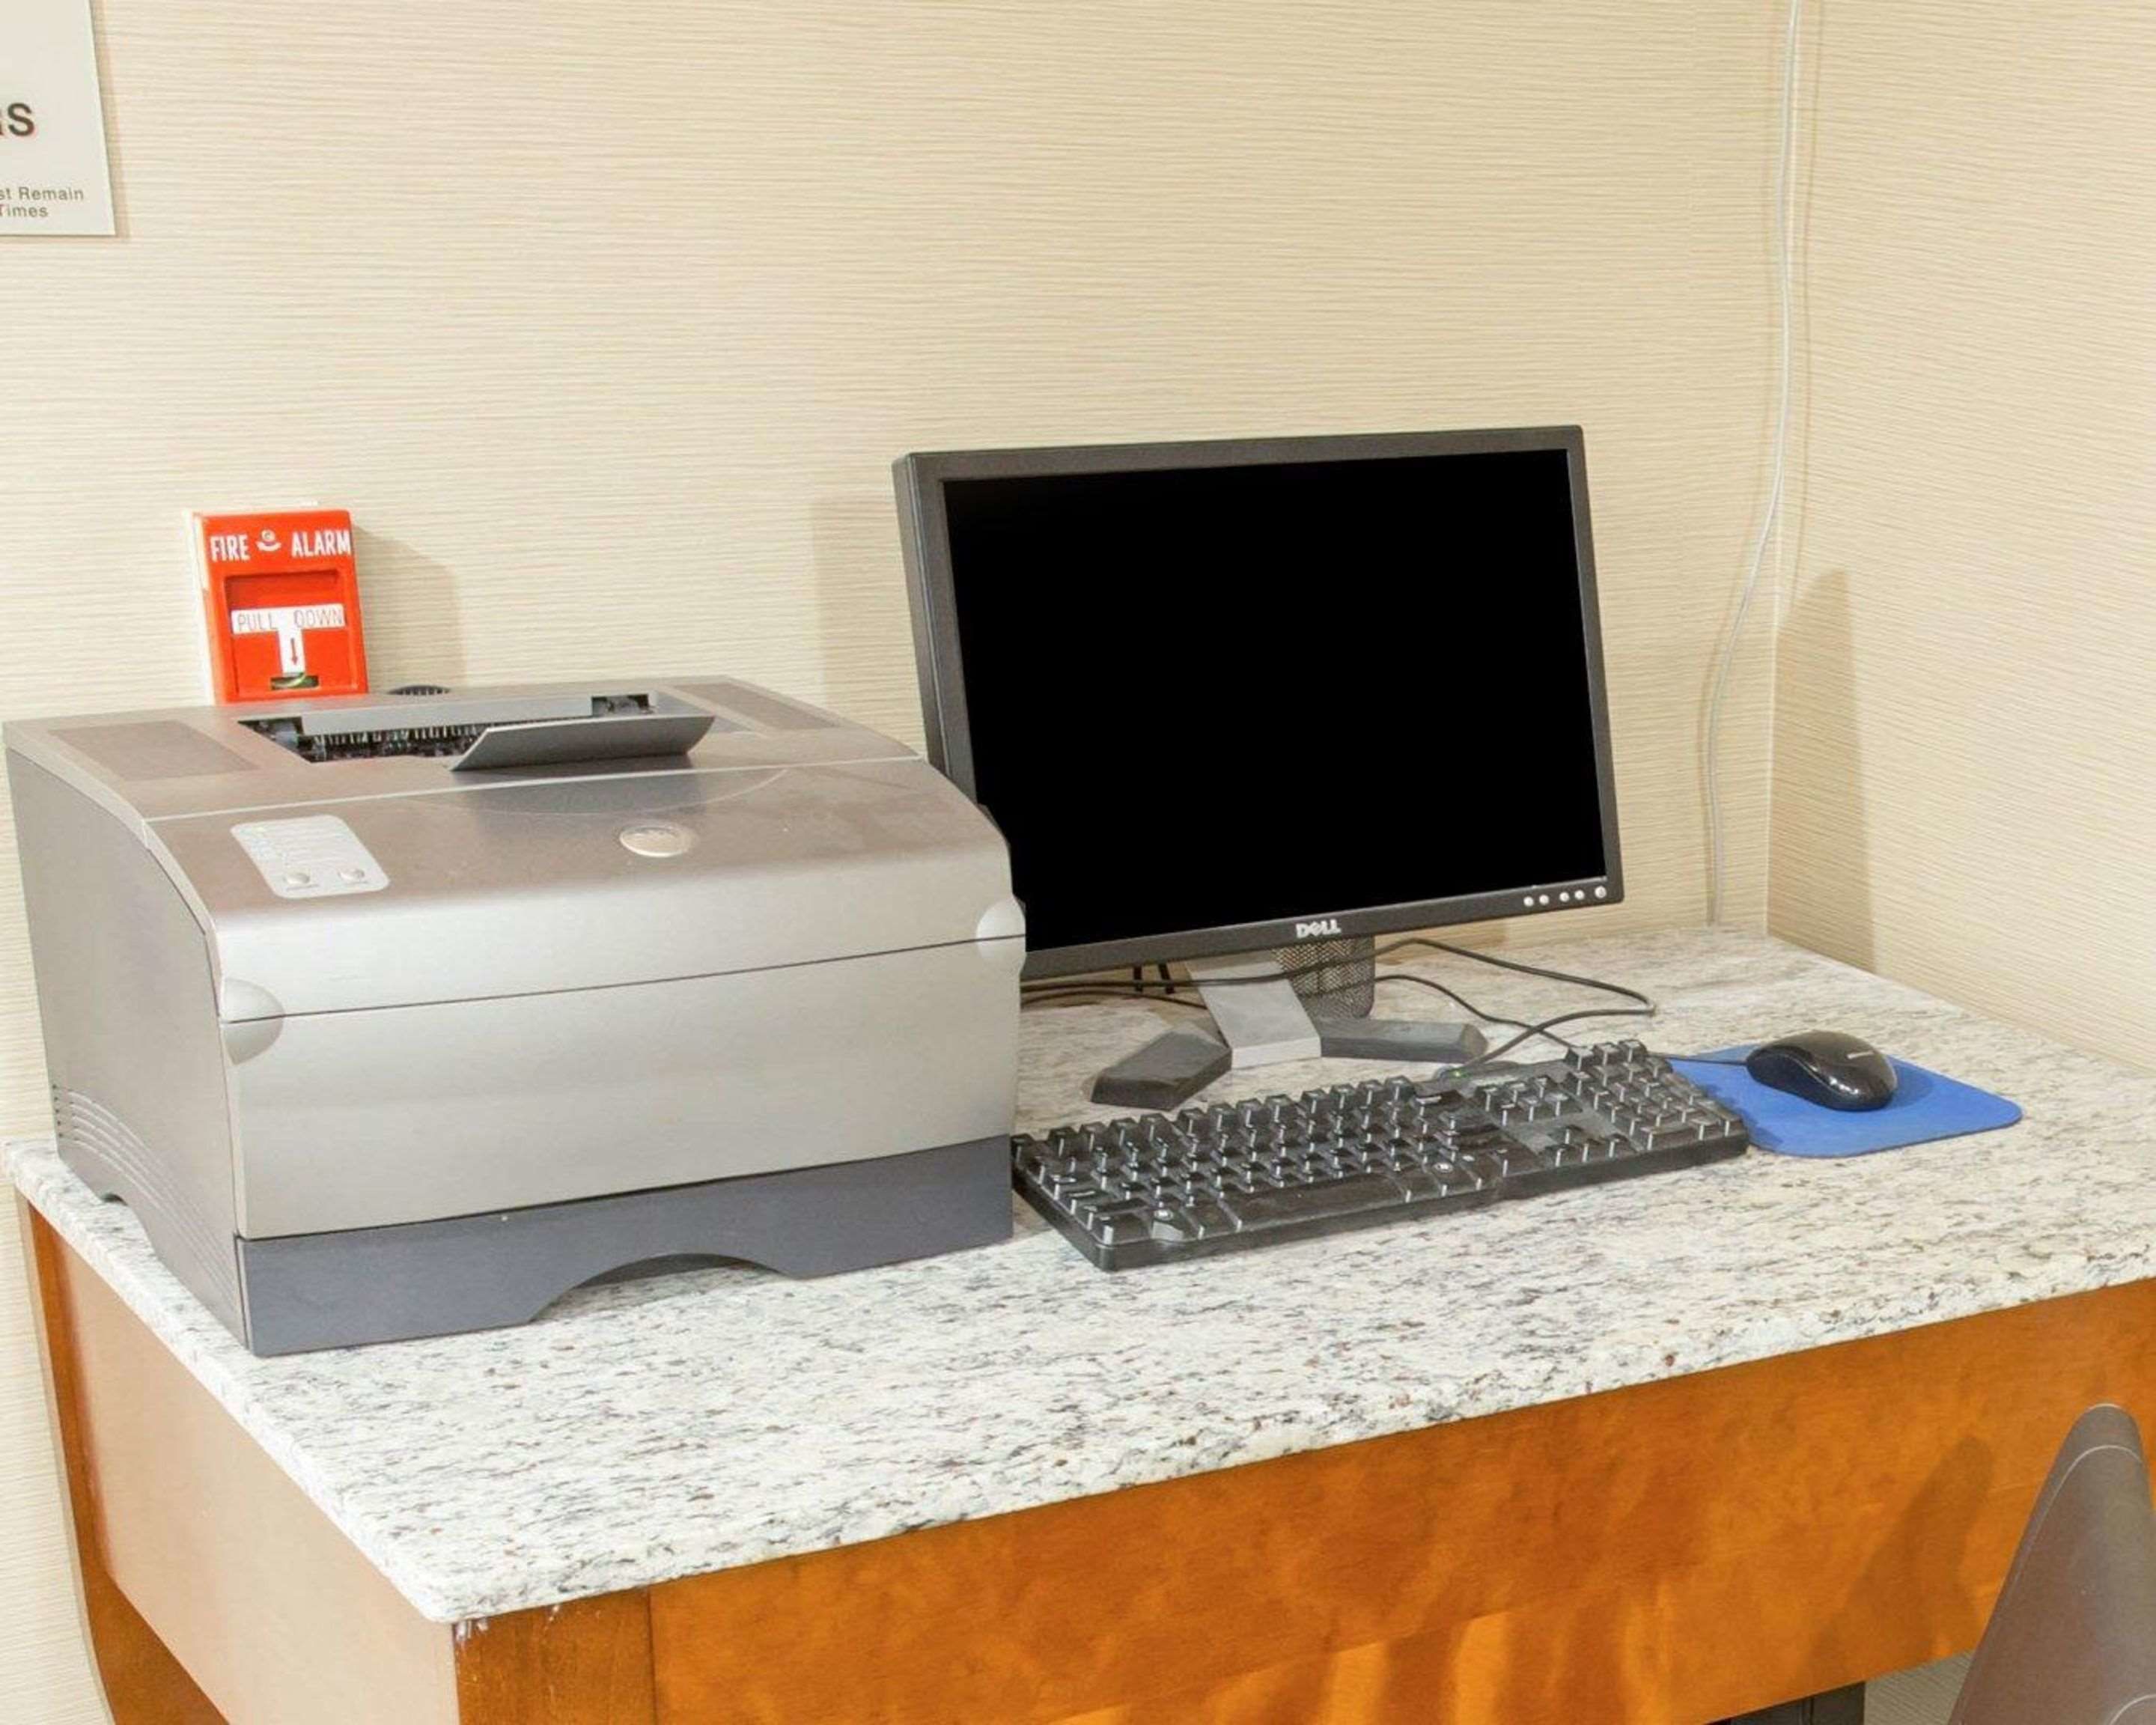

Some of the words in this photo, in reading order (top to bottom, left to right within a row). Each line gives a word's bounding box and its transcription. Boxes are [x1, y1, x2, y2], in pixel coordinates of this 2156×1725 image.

[19, 186, 84, 201] Remain
[210, 535, 250, 562] FIRE
[291, 529, 352, 558] ALARM
[237, 612, 278, 631] PULL
[293, 607, 343, 627] DOWN
[1295, 919, 1342, 939] DELL
